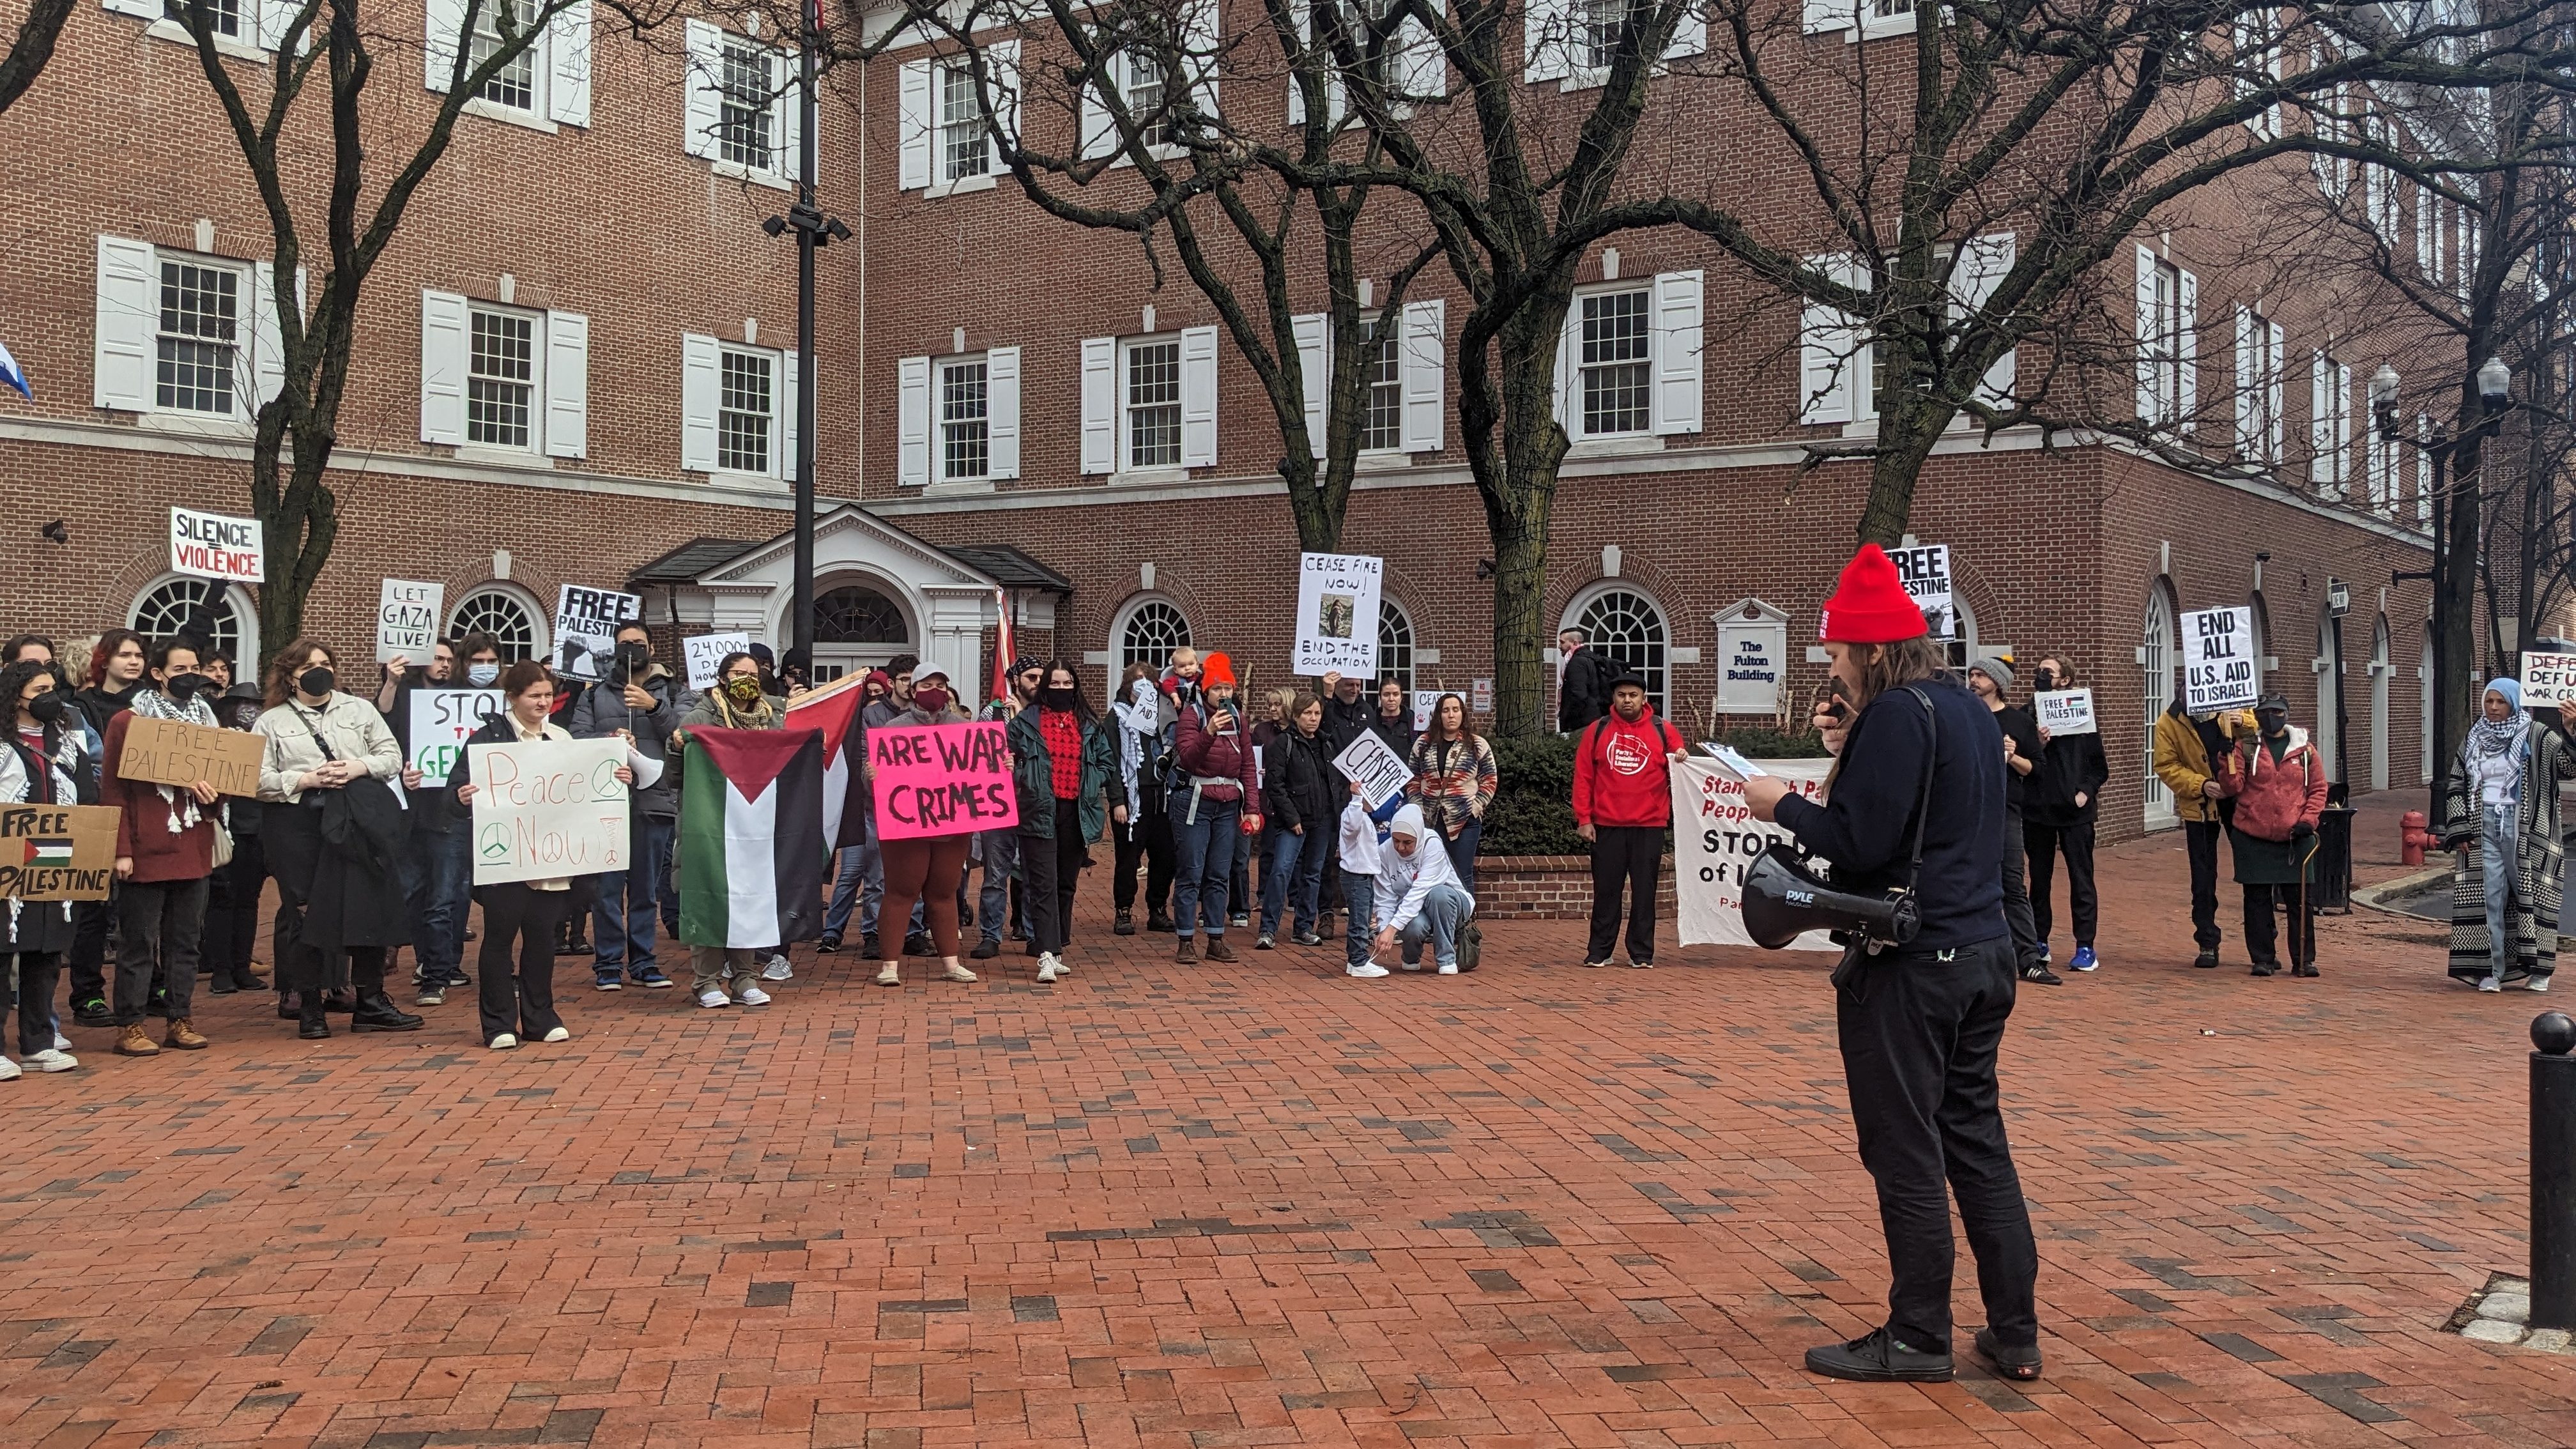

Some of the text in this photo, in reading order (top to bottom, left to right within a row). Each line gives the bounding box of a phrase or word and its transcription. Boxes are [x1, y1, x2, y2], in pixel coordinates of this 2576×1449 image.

[176, 514, 254, 548] SILENCE
[174, 542, 260, 576] VIOLENCE
[1305, 557, 1378, 574] CEASE FIRE
[394, 587, 429, 601] LET
[1325, 576, 1367, 597] NOW!
[564, 587, 633, 622] FREE
[383, 604, 433, 631] GAZA
[558, 615, 620, 638] PALESTI
[2197, 611, 2235, 636] END
[385, 630, 431, 648] LIVE!
[691, 640, 747, 658] 24,000+
[1302, 640, 1370, 656] END THE
[1740, 641, 1762, 652] The
[2203, 635, 2235, 660] ALL
[1301, 657, 1372, 668] OCCUPATION
[1733, 656, 1768, 666] Fulton
[1727, 670, 1775, 683] Building
[2190, 661, 2251, 687] U.S. AID
[2044, 698, 2064, 710] FREE
[2189, 682, 2253, 703] TO ISRAEL!
[2524, 687, 2552, 699] WAR
[2046, 707, 2089, 719] PALESTINE
[157, 723, 229, 751] FREE
[417, 745, 461, 779] GE
[876, 728, 1007, 773] ARE WAR
[123, 747, 255, 793] PALESTINE
[487, 751, 585, 807] Peace
[1346, 739, 1407, 806] CEASEFIRE
[888, 782, 1011, 829] CRIMES
[1701, 799, 1756, 824] Peop
[1, 808, 69, 838] FREE
[0, 865, 109, 897] PALESTINE
[1390, 862, 1419, 882] PALES
[1699, 862, 1728, 882] of
[1786, 889, 1815, 903] PYLE
